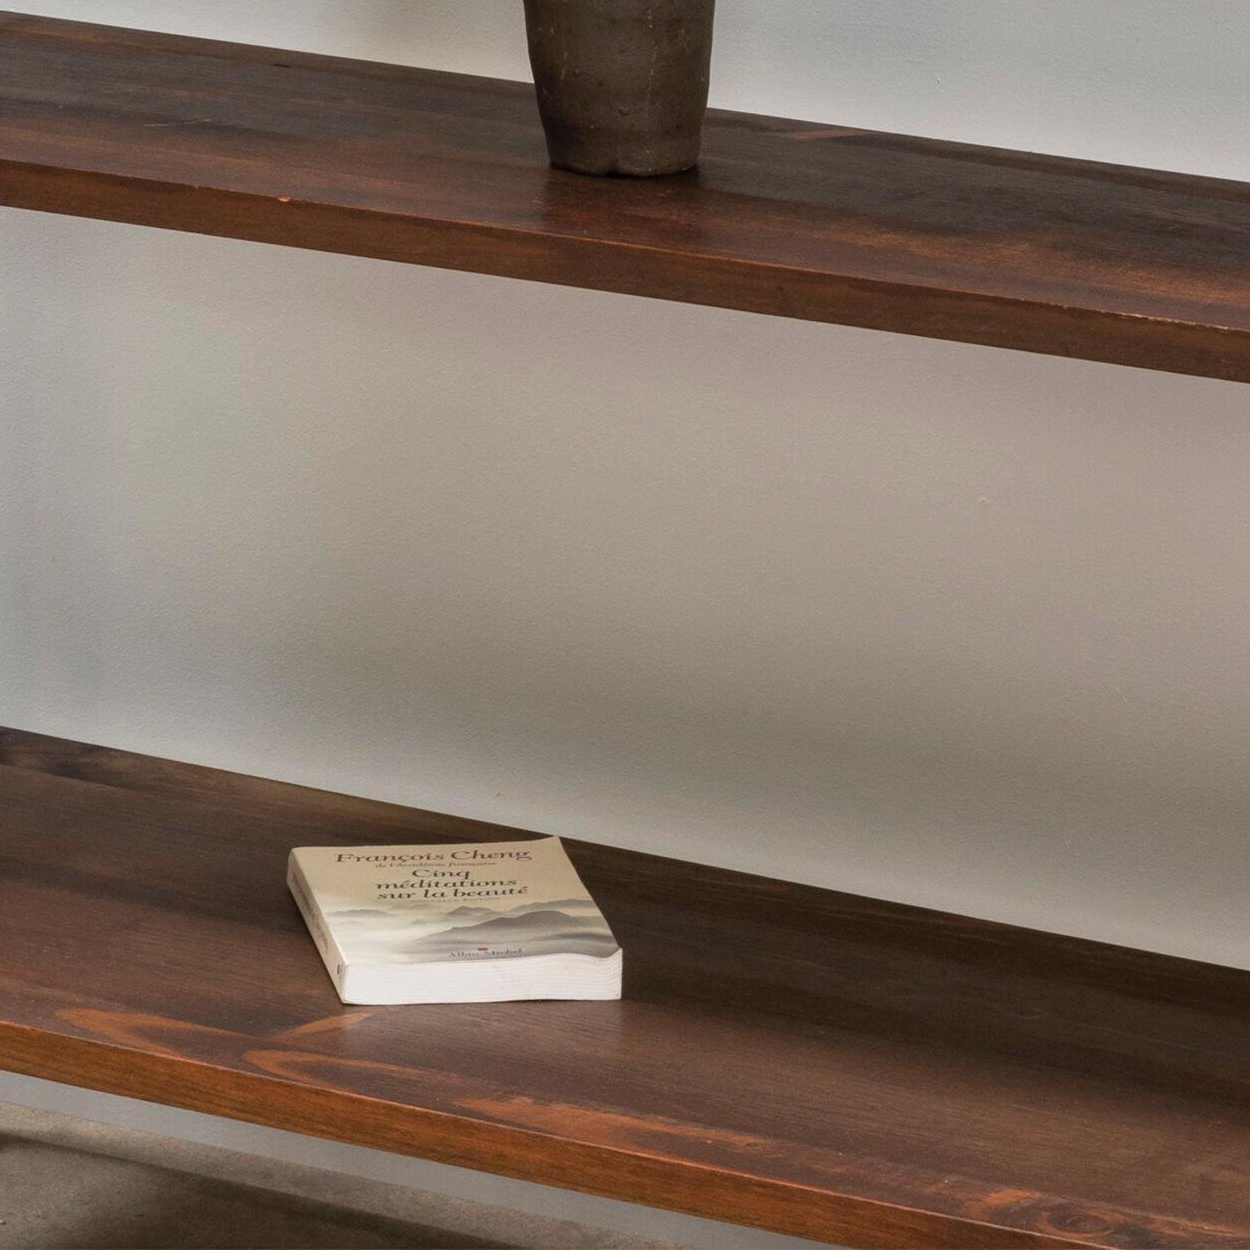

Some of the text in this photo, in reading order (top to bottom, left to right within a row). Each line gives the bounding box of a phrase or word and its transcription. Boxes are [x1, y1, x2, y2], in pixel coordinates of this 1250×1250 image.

[335, 850, 532, 863] François Cheng
[412, 869, 470, 880] Cinq
[376, 880, 517, 890] méditations
[377, 892, 416, 900] sur
[423, 889, 446, 898] la
[453, 886, 528, 897] beauté
